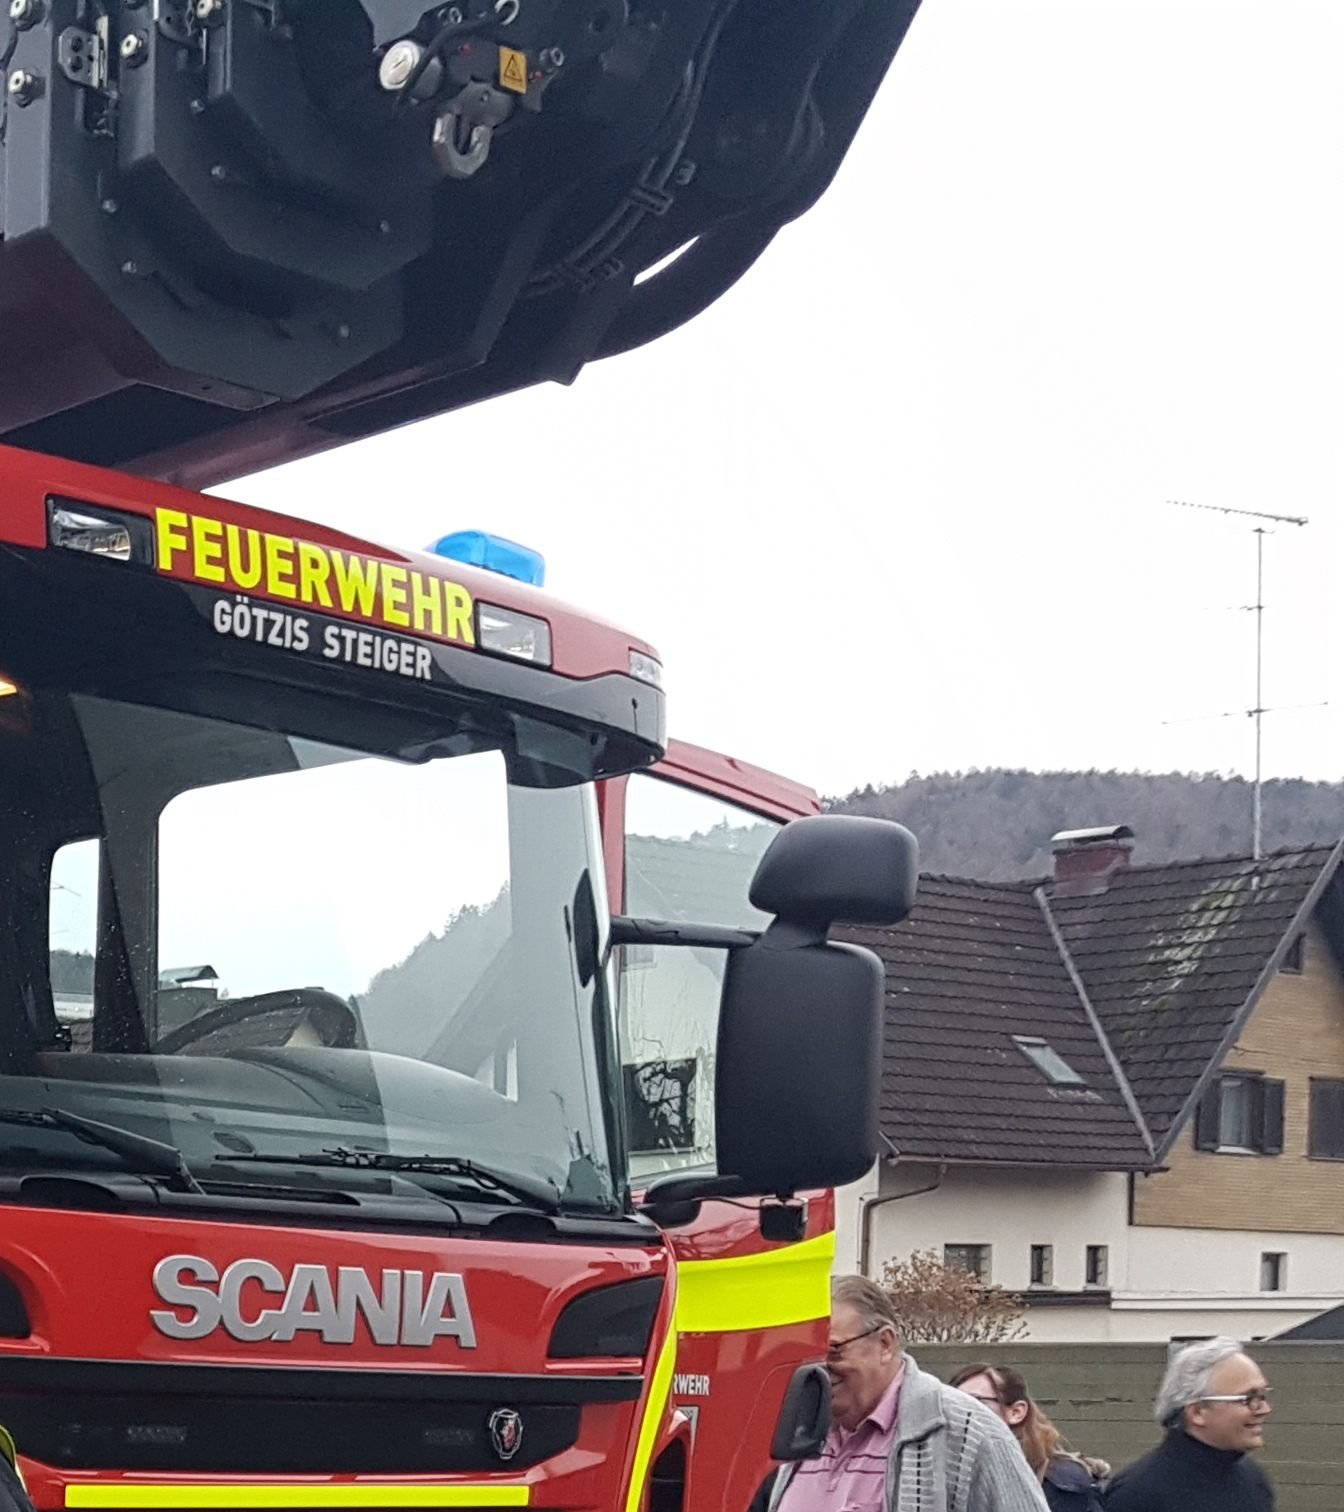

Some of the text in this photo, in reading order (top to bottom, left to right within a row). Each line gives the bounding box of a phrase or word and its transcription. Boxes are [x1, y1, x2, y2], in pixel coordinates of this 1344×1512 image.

[155, 507, 476, 646] FEUERWEHR
[214, 595, 432, 680] GÖTZIS STEIGER
[149, 1254, 477, 1348] SCANIA
